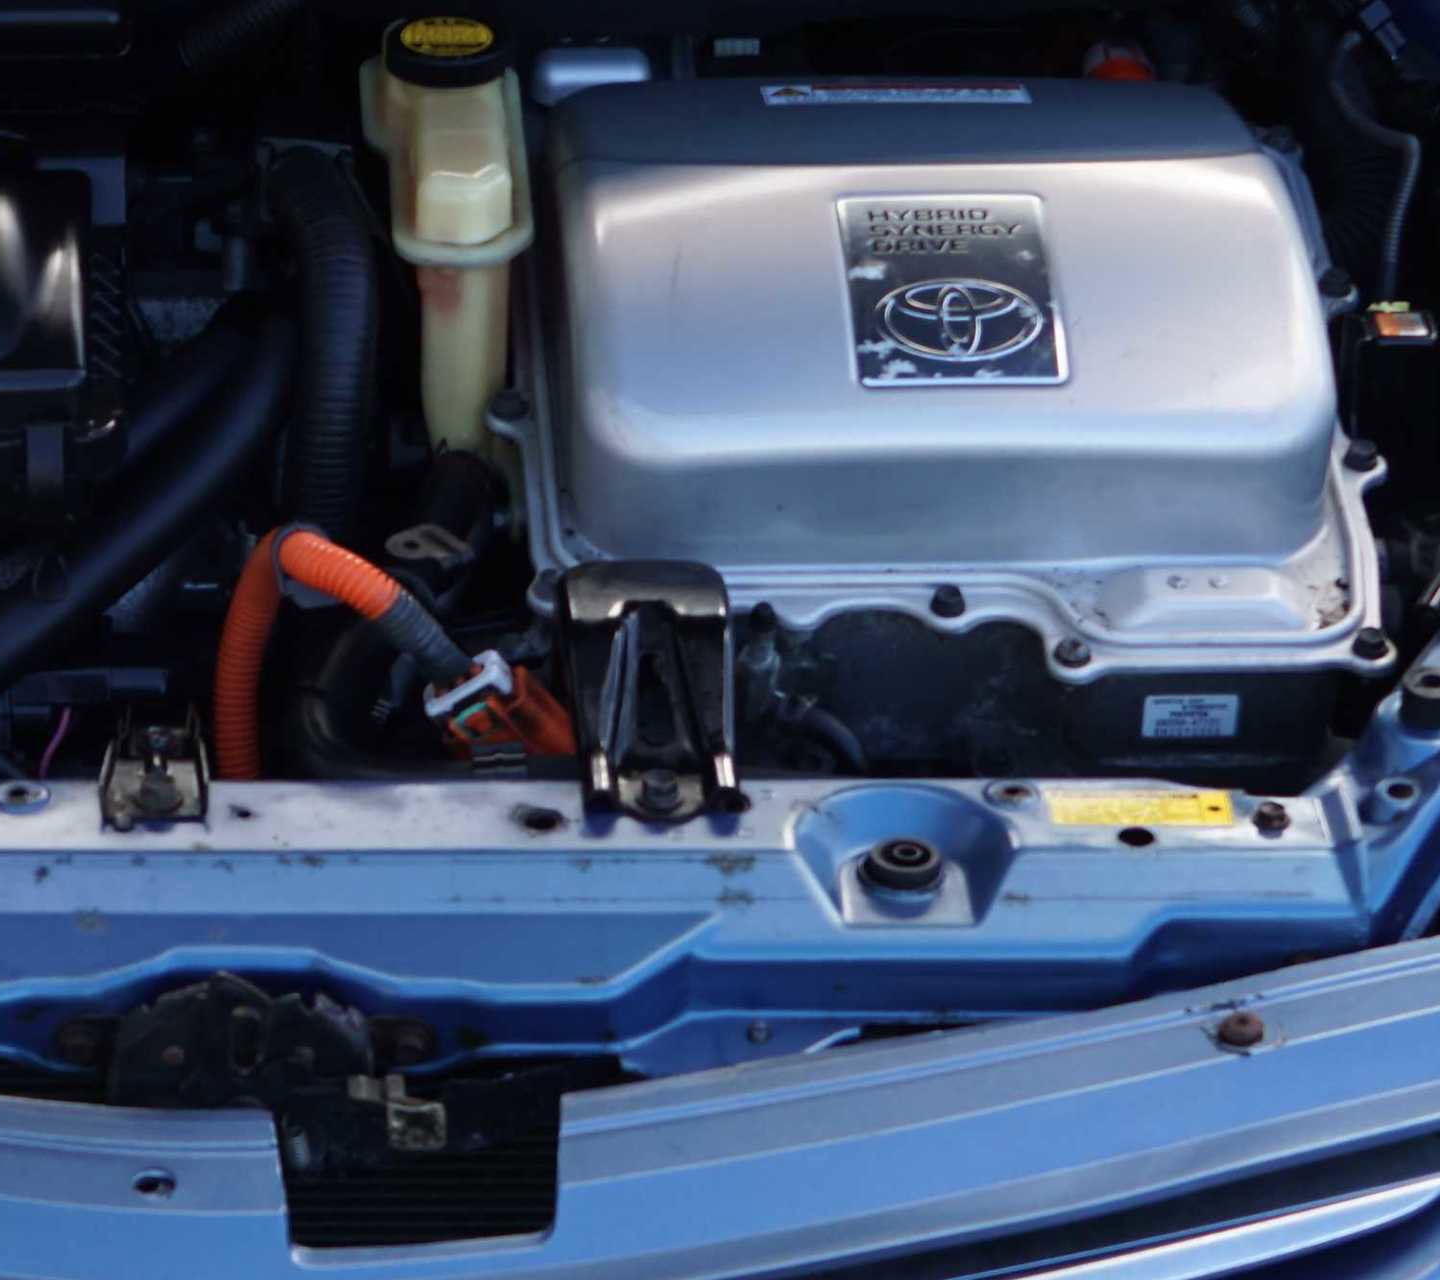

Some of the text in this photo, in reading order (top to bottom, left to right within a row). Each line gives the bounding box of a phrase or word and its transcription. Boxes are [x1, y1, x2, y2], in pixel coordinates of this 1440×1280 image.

[868, 208, 990, 221] HYBRID
[870, 223, 1021, 237] SYNERGY
[871, 238, 969, 254] DRIVE
